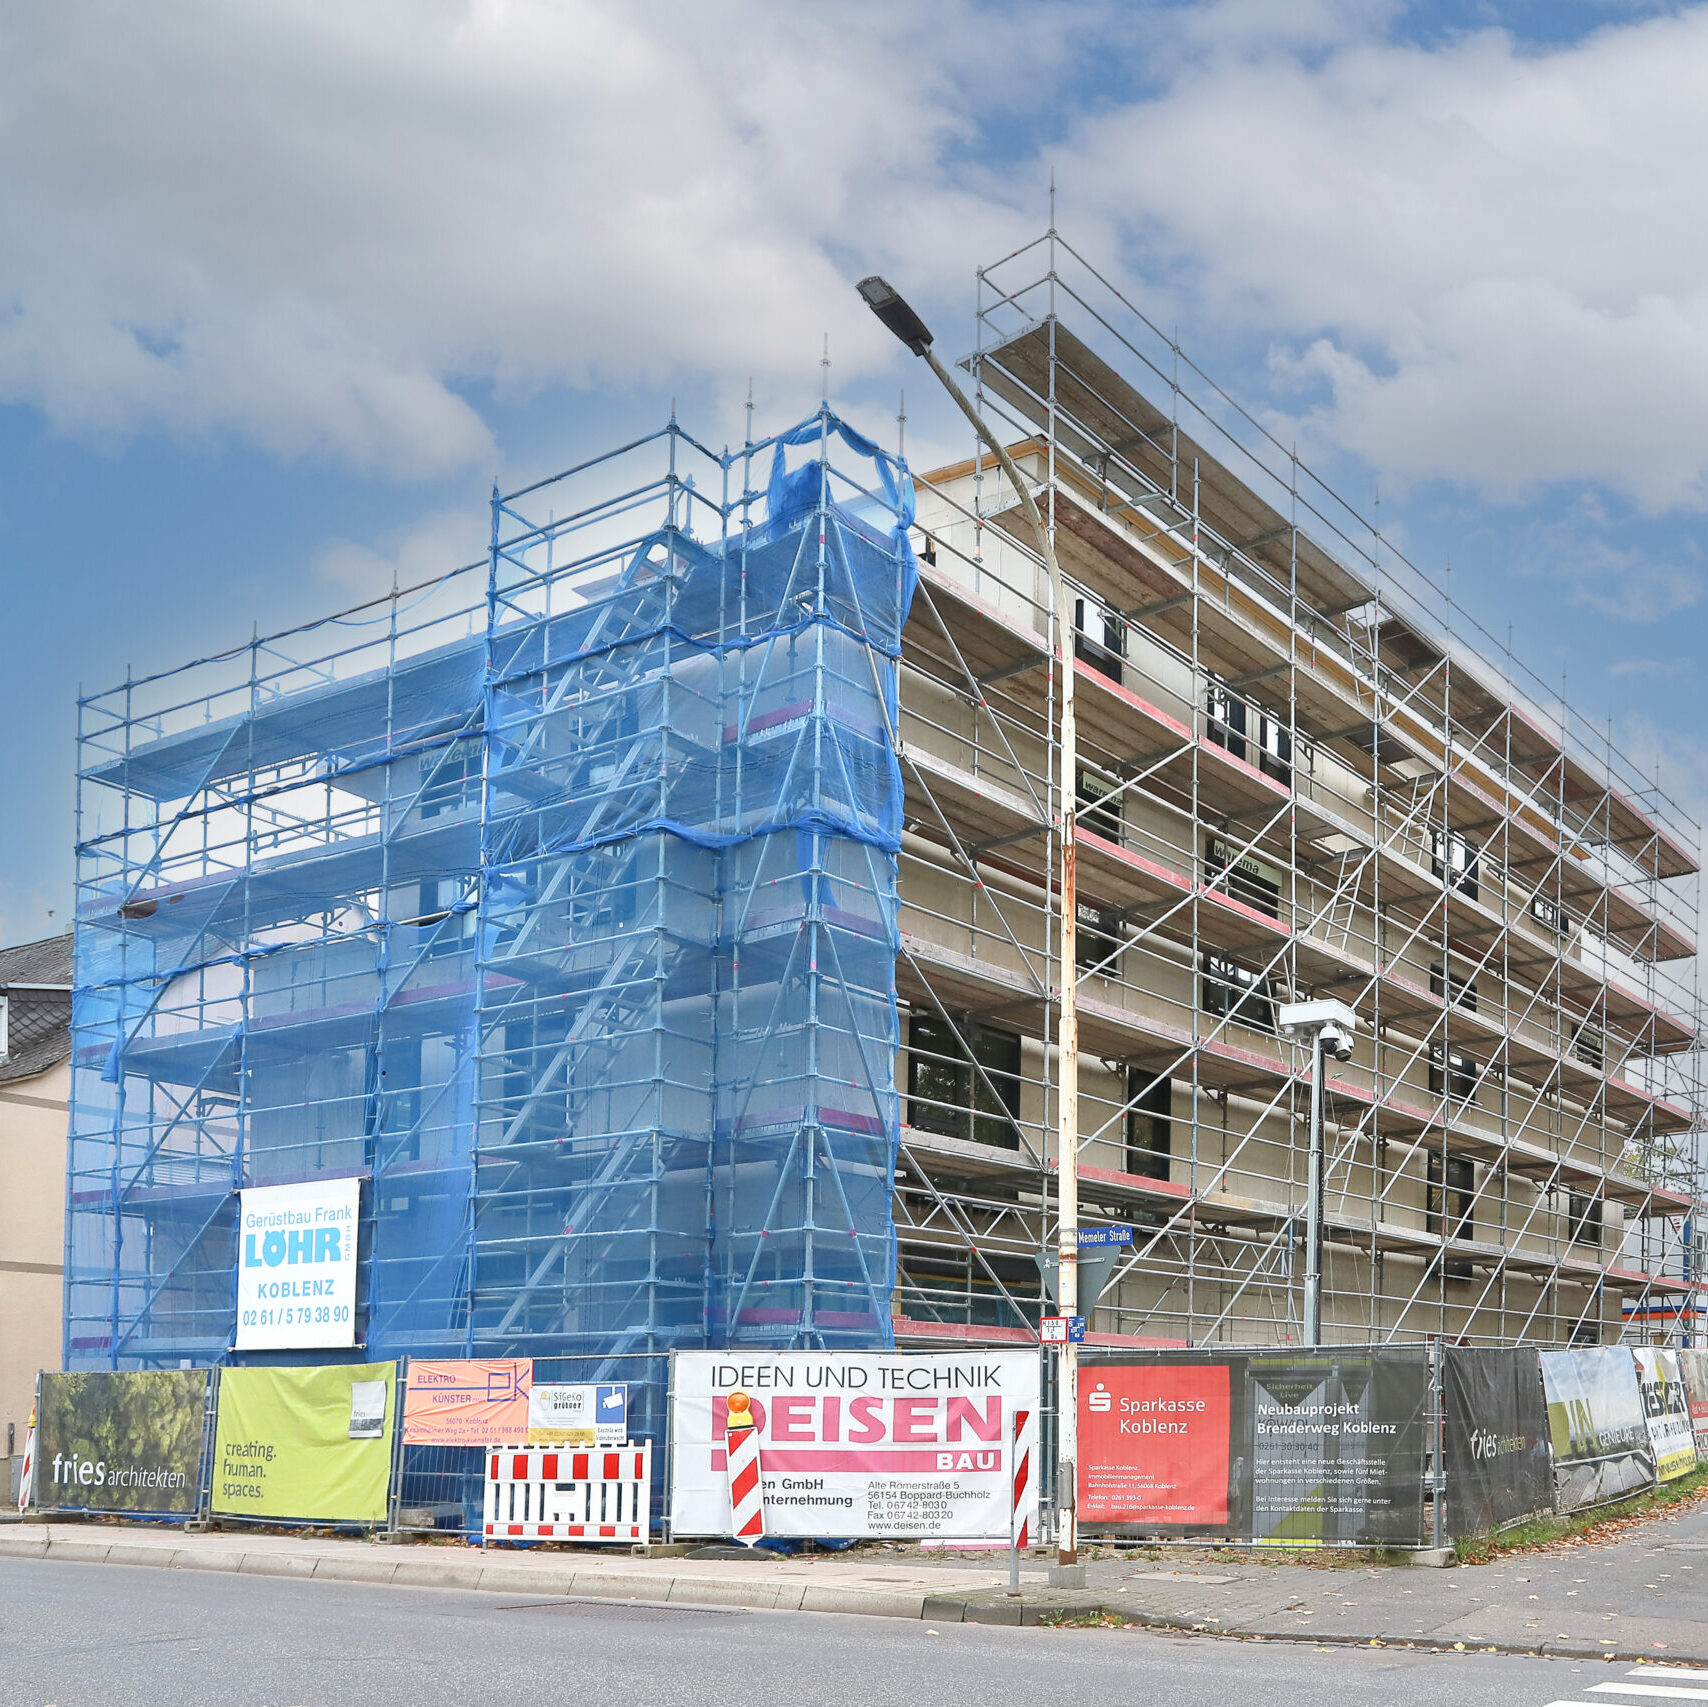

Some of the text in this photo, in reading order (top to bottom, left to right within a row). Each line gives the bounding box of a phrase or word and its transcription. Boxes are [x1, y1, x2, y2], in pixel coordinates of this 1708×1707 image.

[246, 1205, 352, 1228] Gerüstbau Frank
[1078, 1229, 1131, 1244] Memeler Straße
[245, 1227, 341, 1268] LÖHR
[257, 1279, 335, 1299] KOBLENZ
[243, 1310, 257, 1326] 02
[260, 1309, 273, 1325] 61
[286, 1308, 293, 1324] 5
[297, 1307, 311, 1323] 79
[315, 1306, 330, 1323] 38
[333, 1305, 349, 1322] 90
[417, 1375, 457, 1383] ELEKTRO
[711, 1365, 1002, 1390] IDEEN UND TECHNIK
[432, 1392, 471, 1403] KÜNSTER
[1120, 1396, 1206, 1416] Sparkasse
[1258, 1403, 1360, 1417] Neubauprojekt
[711, 1395, 1002, 1444] DEISEN
[1120, 1419, 1188, 1434] Koblenz
[1257, 1421, 1397, 1436] Brenderweg Koblenz
[226, 1441, 277, 1462] creating.
[1470, 1428, 1498, 1460] fries
[223, 1458, 266, 1478] human.
[936, 1452, 995, 1470] BAU
[1336, 1458, 1386, 1466] Geschäftsstelle
[52, 1452, 186, 1488] fries architekten
[1268, 1468, 1301, 1476] Sparkasse
[222, 1483, 264, 1499] spaces.
[781, 1478, 824, 1490] GmbH
[868, 1481, 960, 1490] Alte Römerstraße 5
[867, 1490, 991, 1501] 56154 Boppard-Buchholz
[868, 1501, 884, 1510] Tel.
[867, 1511, 884, 1520] Fax
[868, 1521, 942, 1530] www.deisen.de
